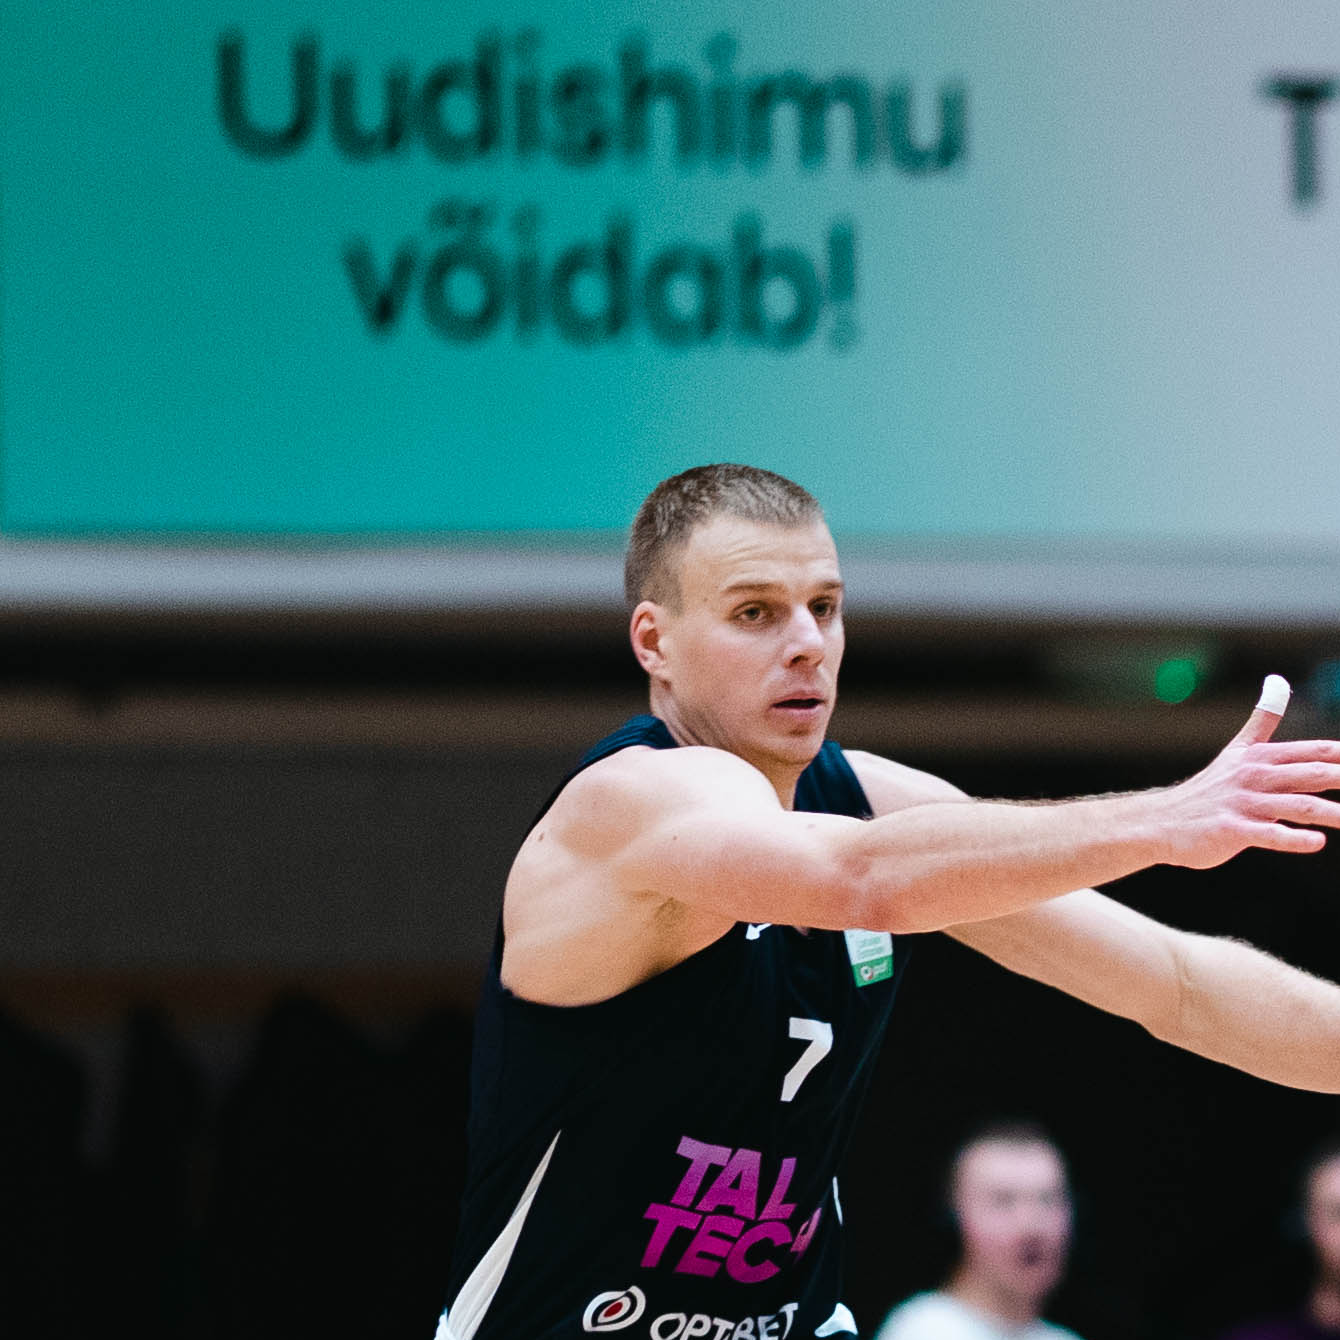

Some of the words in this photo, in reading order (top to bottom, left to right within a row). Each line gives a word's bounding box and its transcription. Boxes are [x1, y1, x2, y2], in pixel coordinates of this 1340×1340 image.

[215, 26, 968, 176] Uudishimu
[780, 1016, 834, 1102] 7
[669, 1134, 798, 1221] TAL
